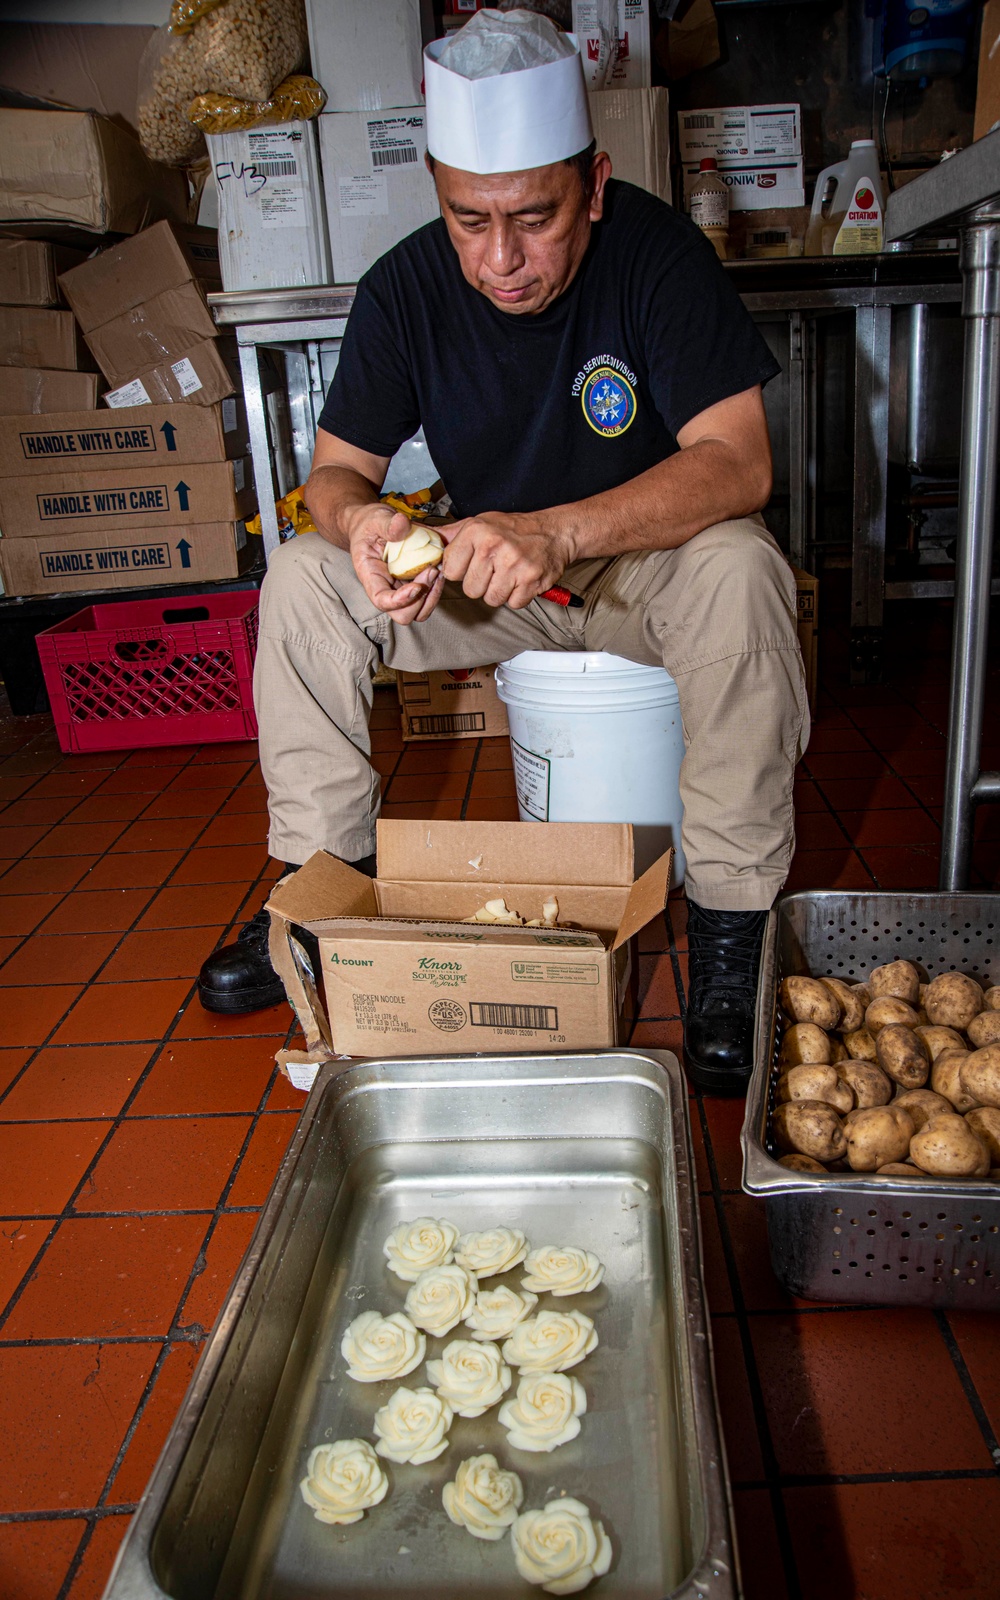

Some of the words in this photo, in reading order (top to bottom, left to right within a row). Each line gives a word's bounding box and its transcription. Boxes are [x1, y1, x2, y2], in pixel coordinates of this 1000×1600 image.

[848, 211, 878, 220] CITATION
[572, 372, 586, 396] FOOD
[583, 354, 610, 374] SERVICE
[26, 433, 77, 454] HANDLE
[78, 432, 112, 452] WITH
[115, 430, 150, 449] CARE
[42, 494, 92, 516] HANDLE
[94, 492, 127, 512] WITH
[130, 490, 164, 509] CARE
[46, 552, 94, 573] HANDLE
[96, 550, 129, 570] WITH
[131, 547, 165, 567] CARE
[799, 597, 810, 608] 61
[441, 682, 483, 691] ORIGINAL
[330, 953, 340, 964] 4
[417, 957, 462, 971] Knorr
[352, 994, 379, 1002] CHICKEN
[380, 996, 405, 1004] NOODLE
[432, 1002, 463, 1016] INSPECTED
